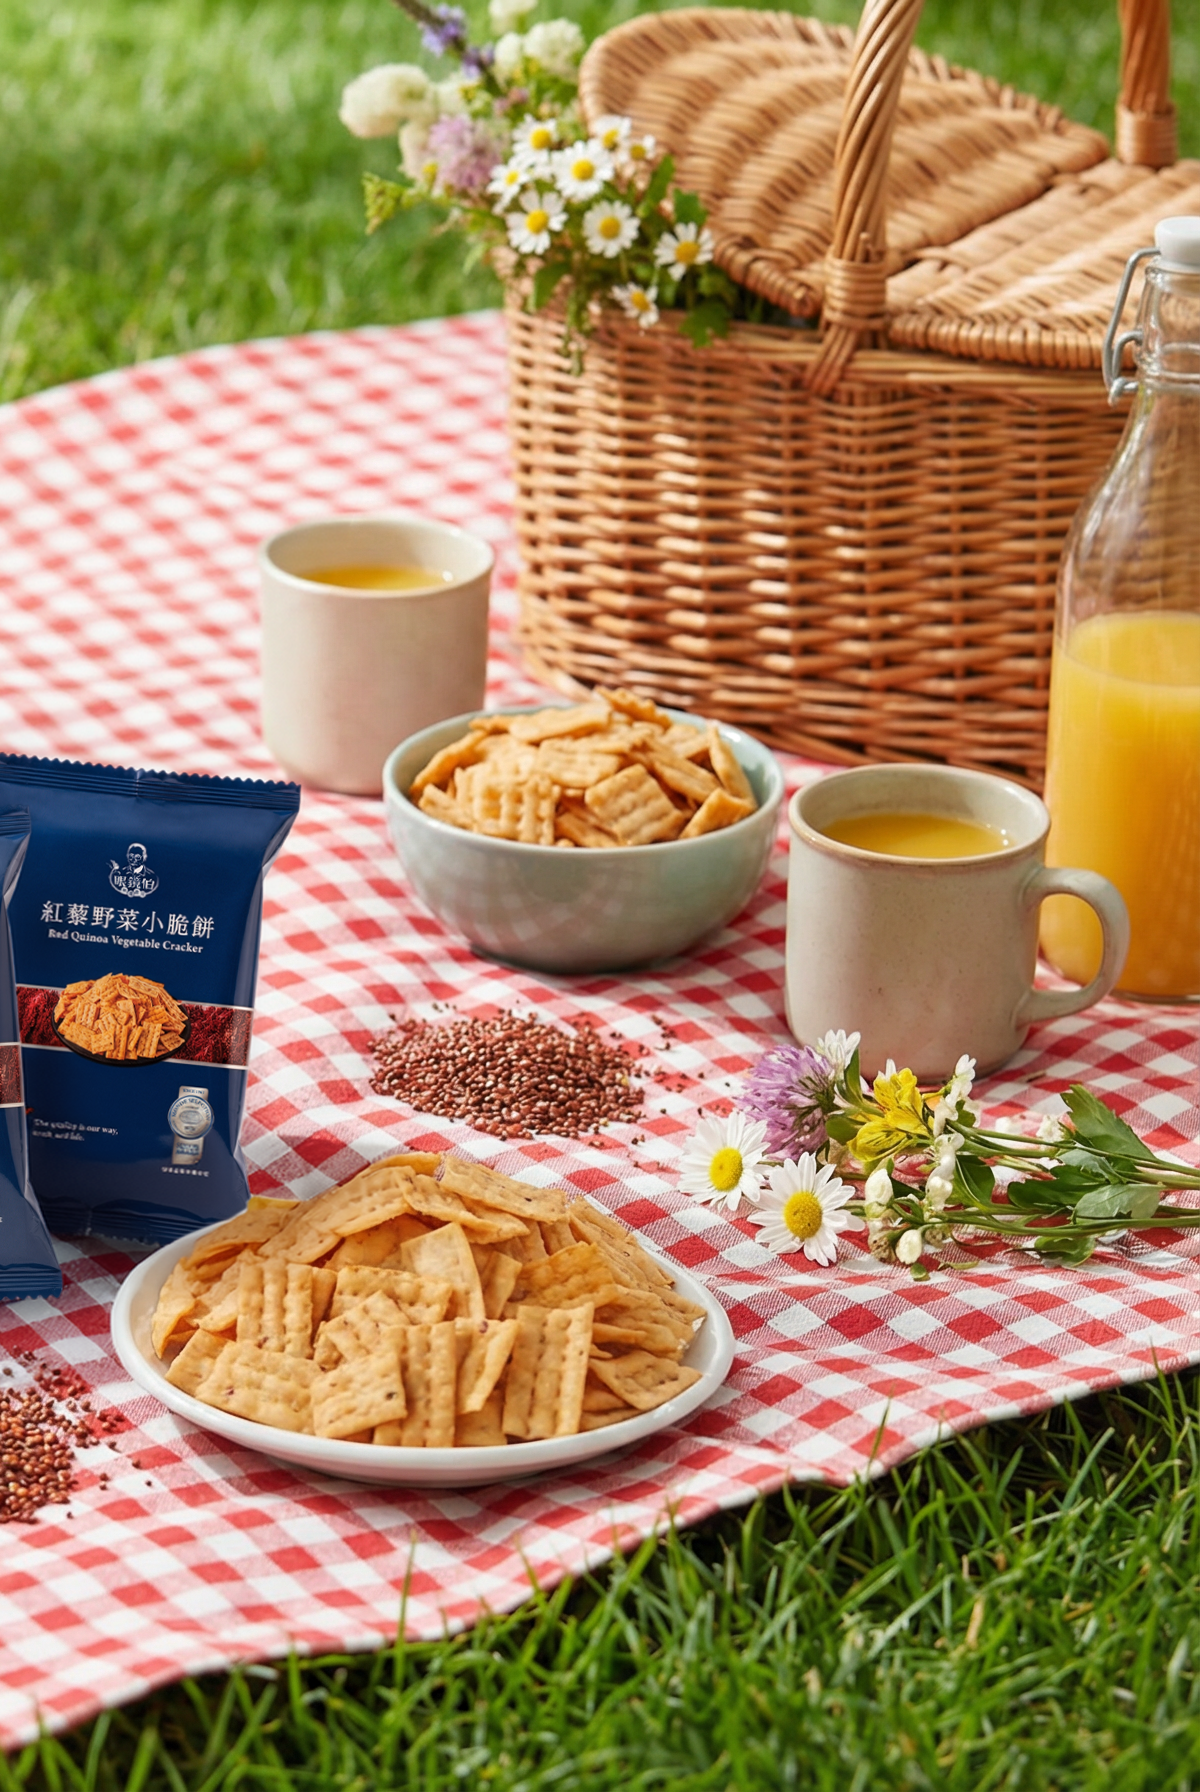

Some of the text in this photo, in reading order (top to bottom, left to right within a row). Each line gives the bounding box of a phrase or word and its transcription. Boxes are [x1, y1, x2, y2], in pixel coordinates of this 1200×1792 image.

[40, 900, 215, 939] 紅藜野菜小脆餅
[48, 929, 204, 954] Red Quinoa Vegetable Cracker
[102, 1127, 119, 1135] way,
